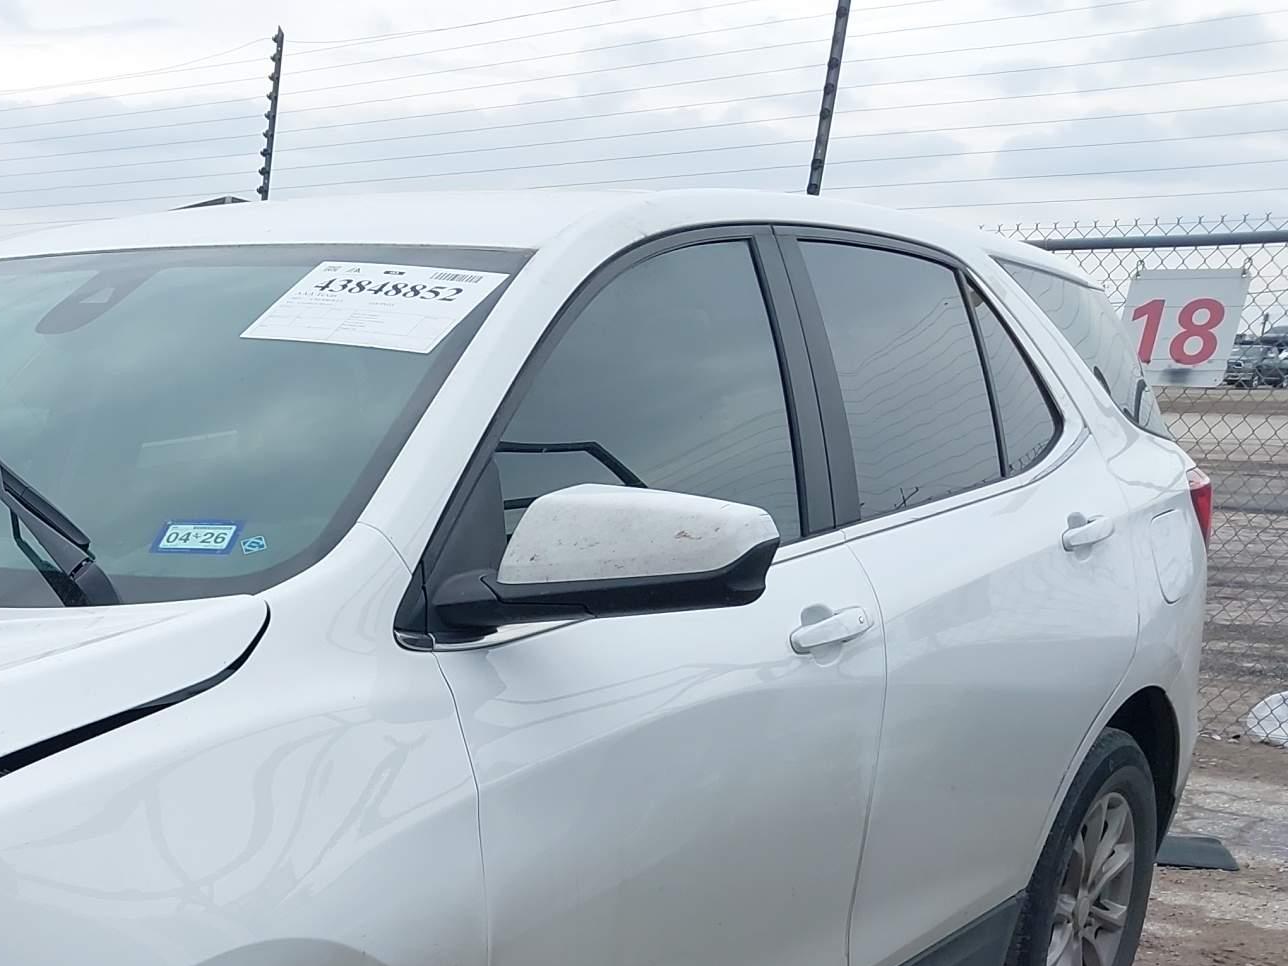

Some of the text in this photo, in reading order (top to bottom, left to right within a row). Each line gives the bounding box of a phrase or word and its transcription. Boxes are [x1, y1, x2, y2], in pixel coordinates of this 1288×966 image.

[314, 278, 464, 302] 43848852
[1132, 298, 1225, 366] 18
[166, 531, 228, 544] 04 26
